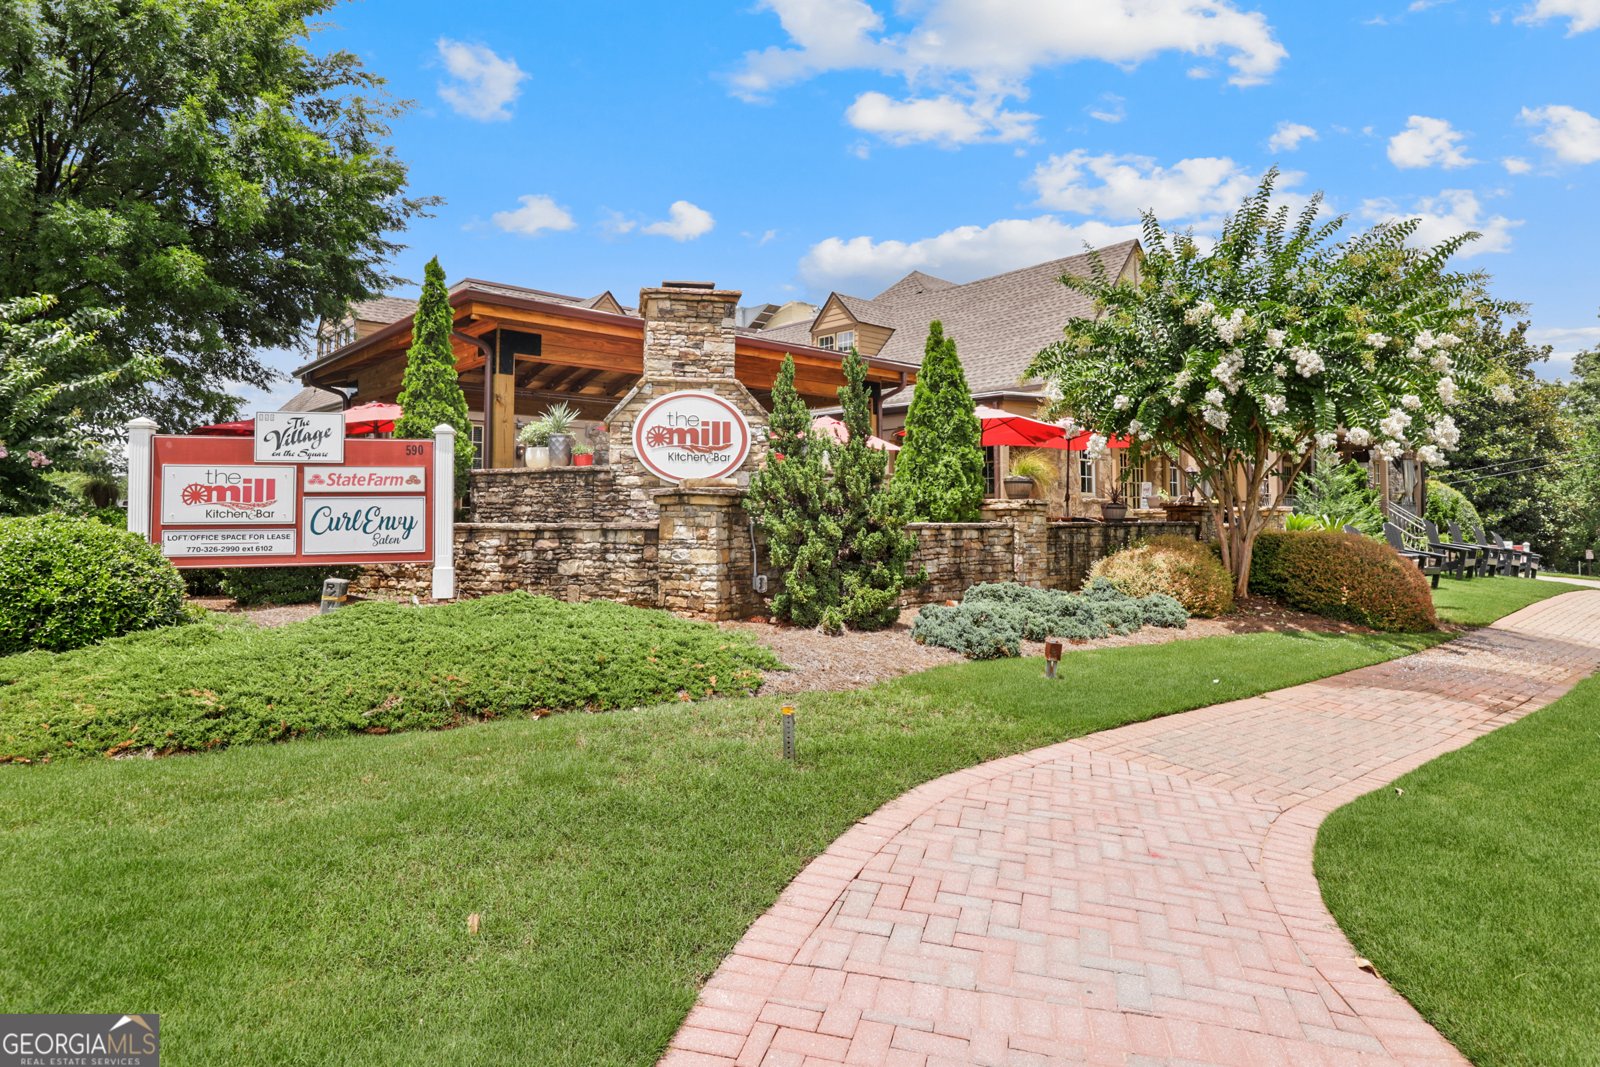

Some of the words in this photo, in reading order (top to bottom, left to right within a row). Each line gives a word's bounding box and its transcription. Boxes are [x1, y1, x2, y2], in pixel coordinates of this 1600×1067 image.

[287, 417, 310, 429] The
[667, 412, 699, 427] the
[263, 427, 331, 451] Village
[667, 421, 731, 446] mill
[297, 448, 328, 459] Square
[405, 445, 424, 456] 590
[205, 469, 241, 484] the
[203, 478, 276, 503] mill
[266, 533, 291, 541] LEASE
[372, 532, 401, 547] Salon
[186, 545, 240, 553] 770-326-2990
